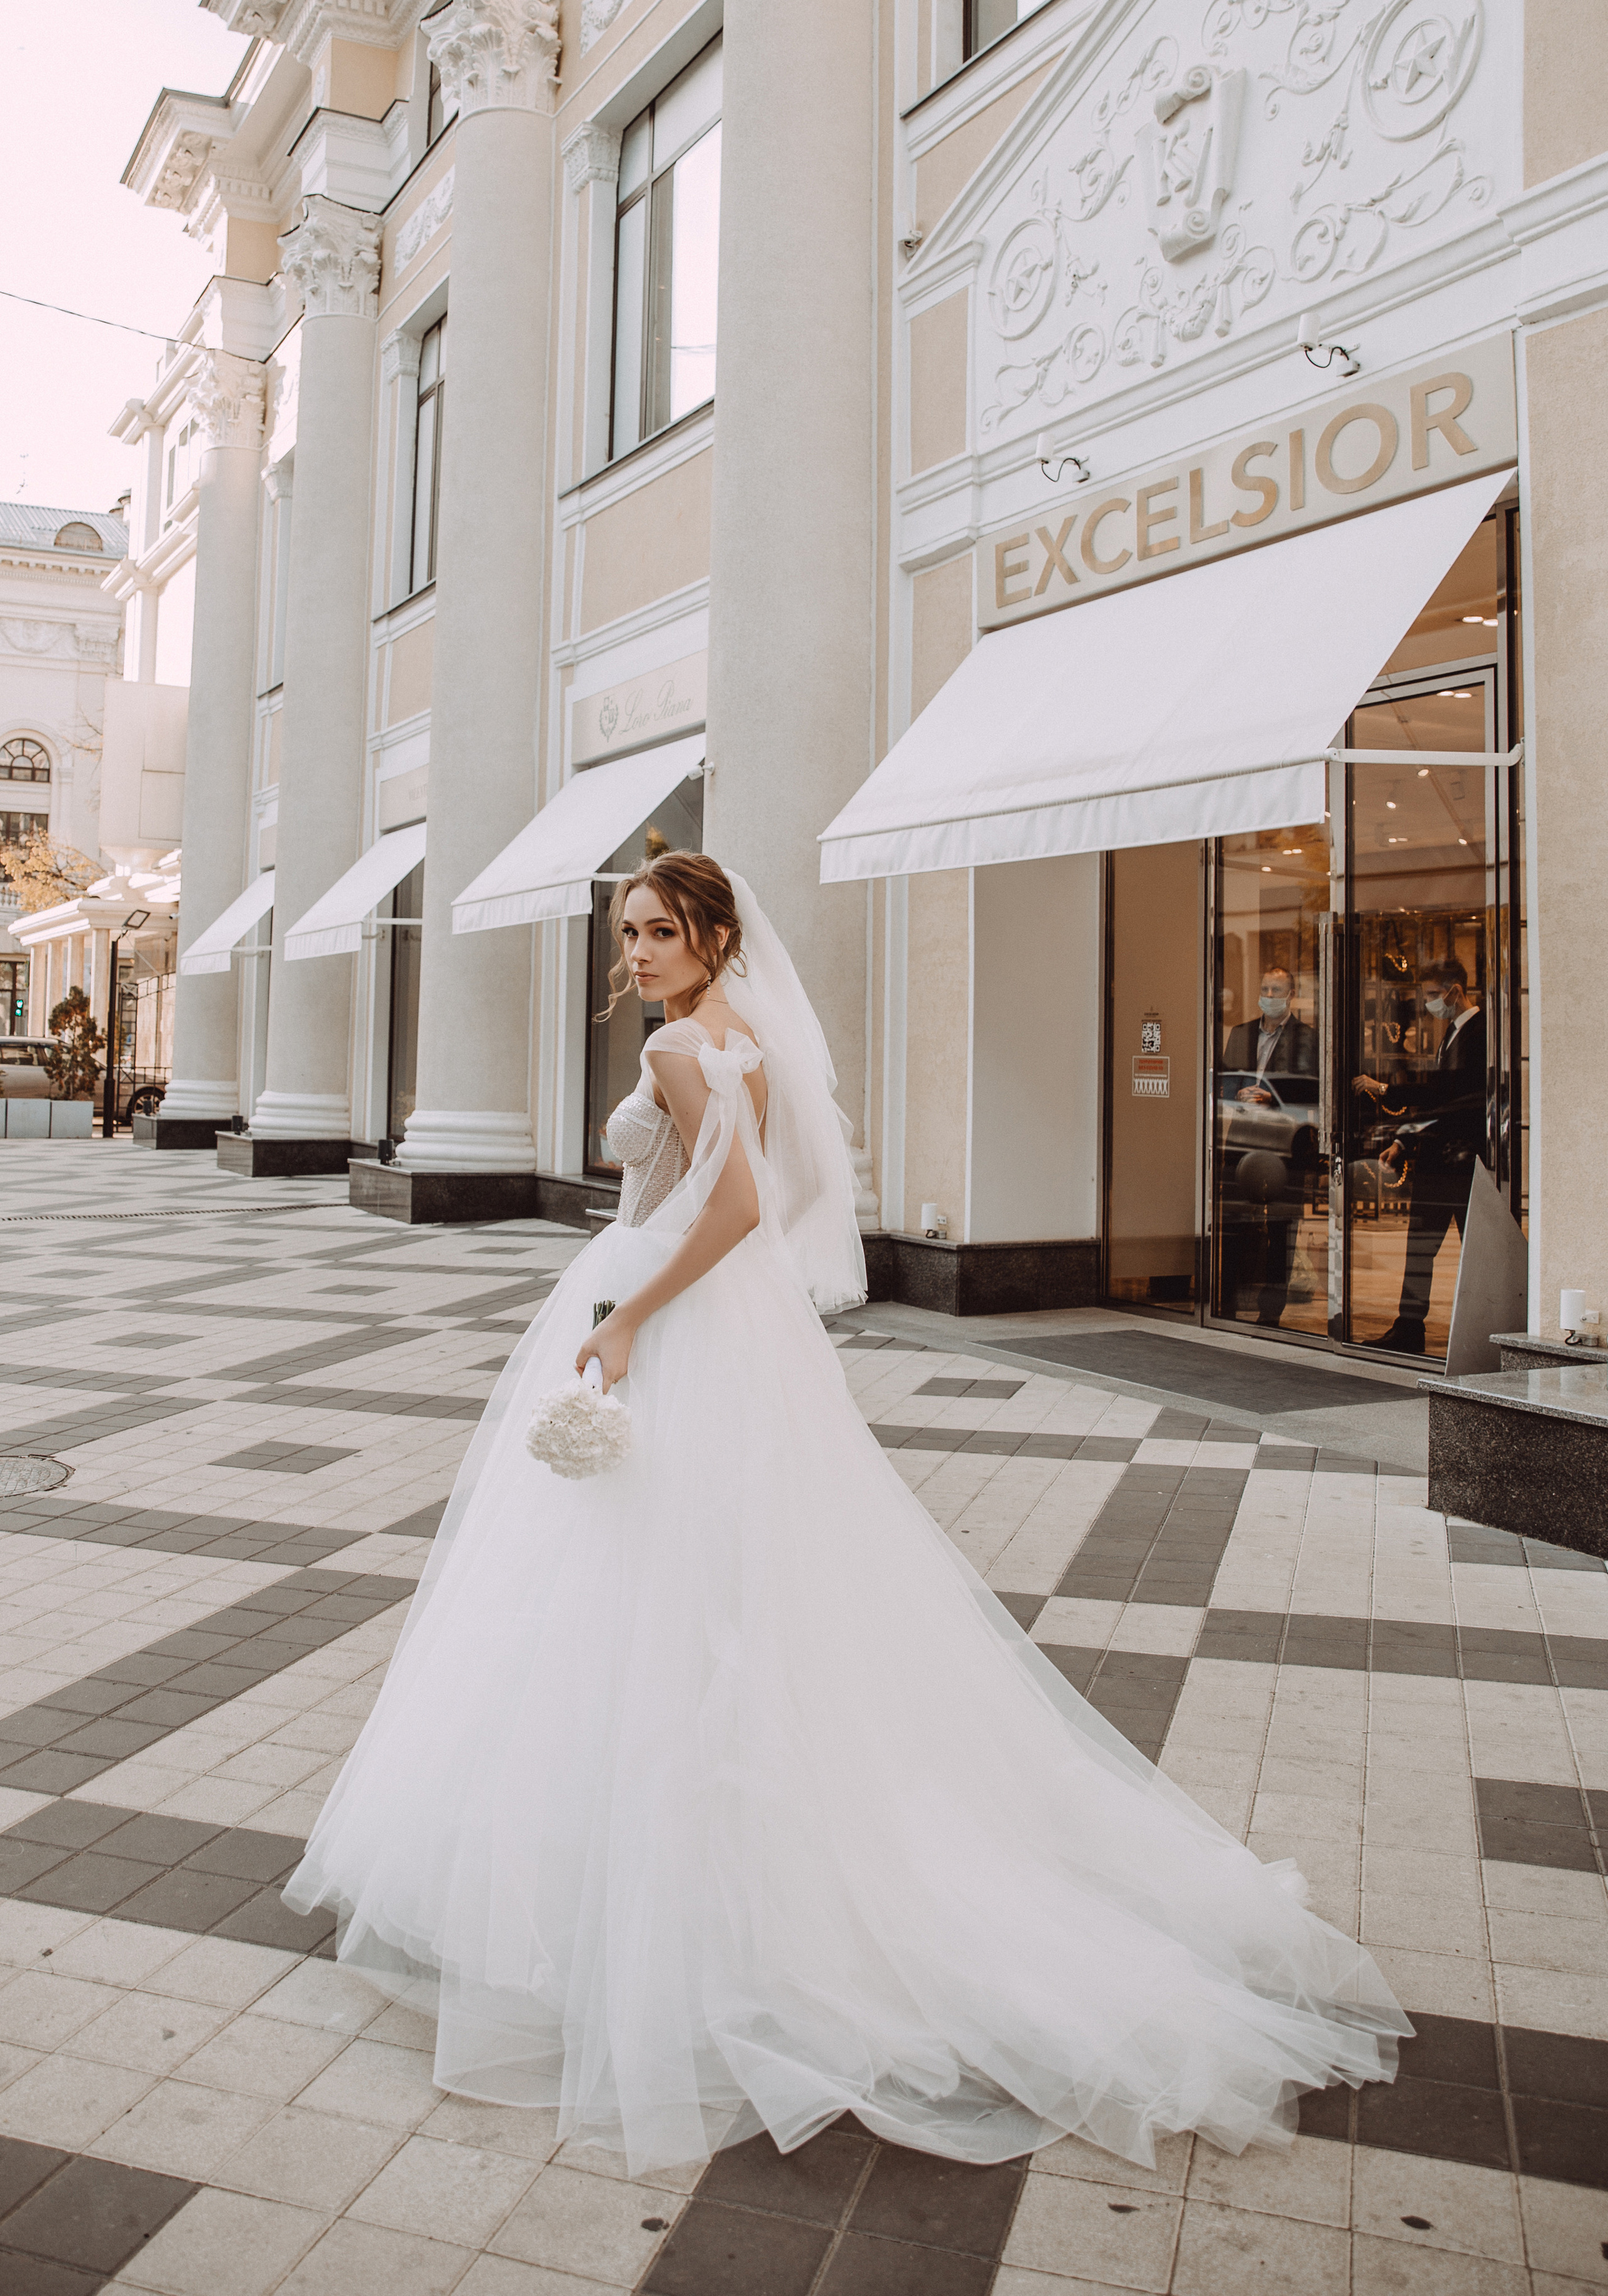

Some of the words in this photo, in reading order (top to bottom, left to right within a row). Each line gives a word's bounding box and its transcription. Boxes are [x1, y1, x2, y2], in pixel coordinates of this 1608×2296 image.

[994, 371, 1477, 609] EXCELSIOR
[618, 688, 651, 735] Loro
[653, 680, 692, 722] Piana
